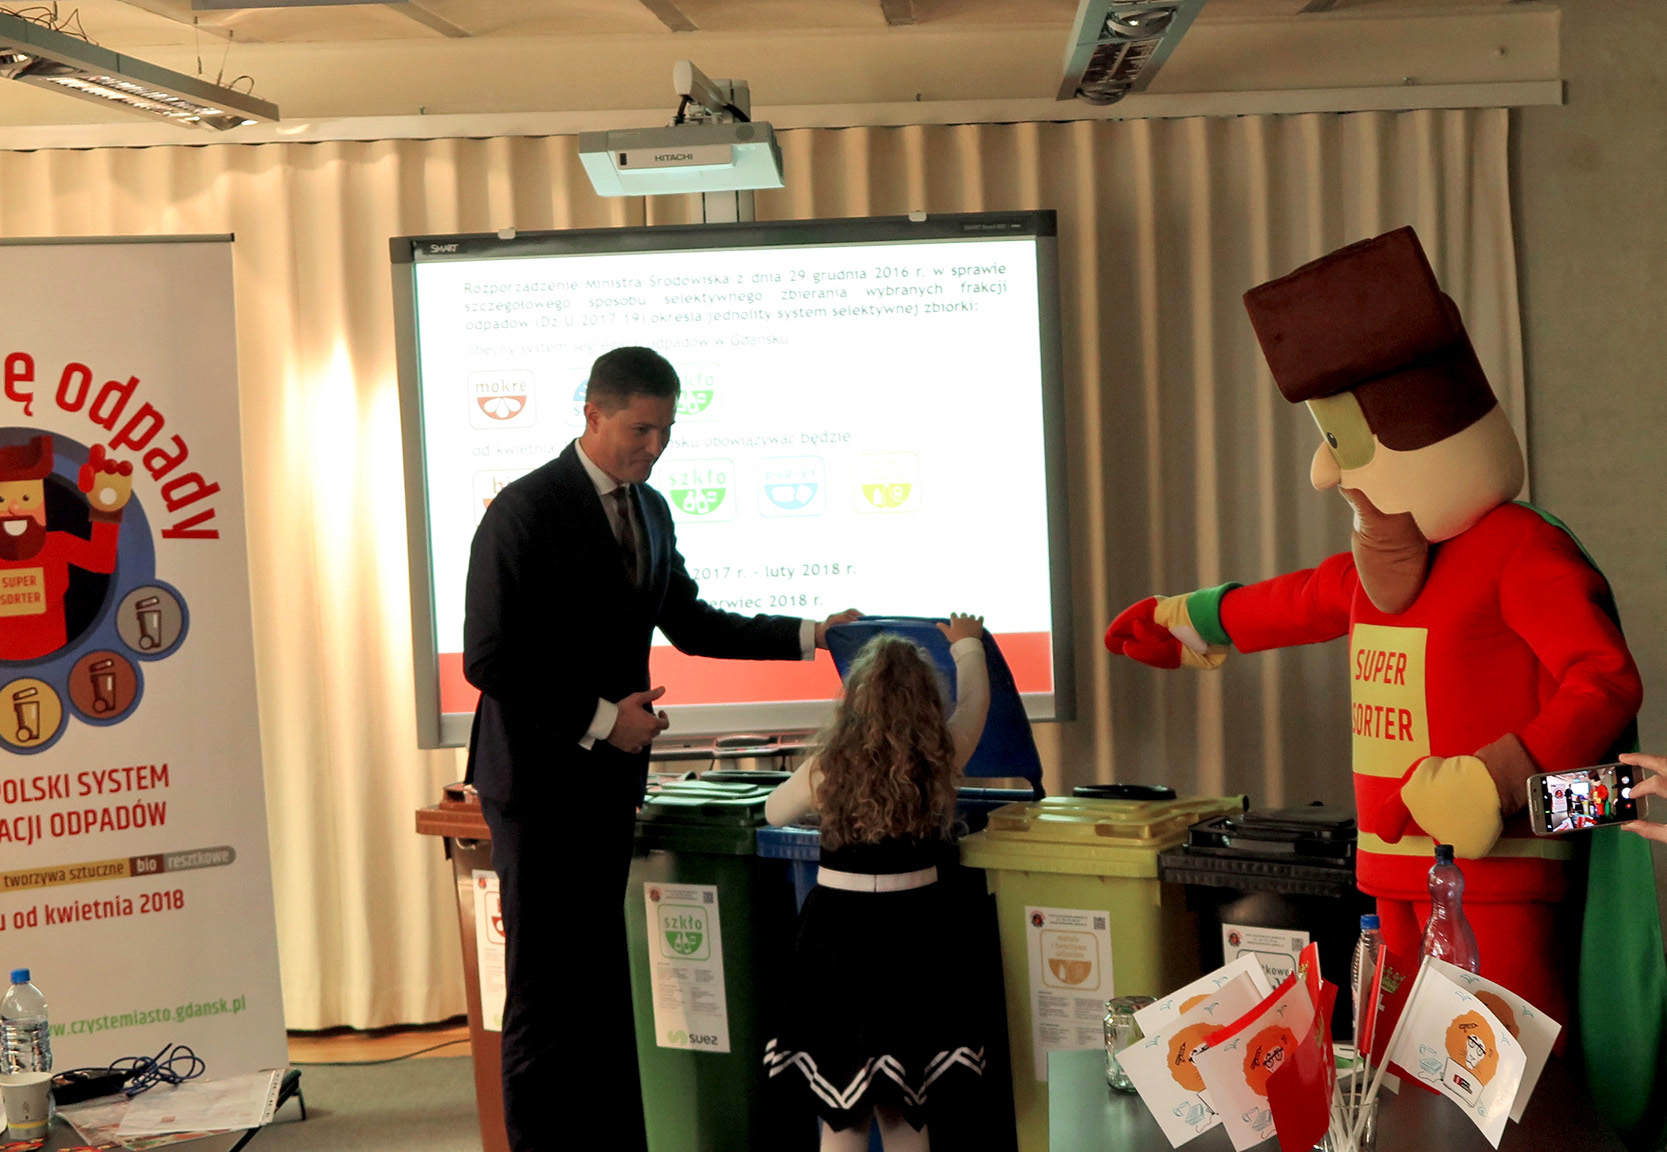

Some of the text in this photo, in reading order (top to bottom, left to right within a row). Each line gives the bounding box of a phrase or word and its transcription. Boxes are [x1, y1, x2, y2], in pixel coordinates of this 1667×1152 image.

[654, 153, 694, 162] HITACHI
[430, 243, 459, 254] SMART
[737, 274, 745, 284] z
[752, 272, 782, 283] dnia
[790, 270, 806, 282] 29
[813, 268, 867, 285] grudnia
[875, 266, 910, 280] 2016
[916, 268, 926, 278] r.
[932, 267, 944, 276] w
[951, 261, 1007, 279] sprawie
[589, 295, 647, 309] sposobu
[664, 291, 763, 307] selektywnego
[781, 287, 848, 301] zbierania
[866, 283, 943, 299] wybranych
[960, 280, 1007, 296] frakcji
[709, 307, 771, 325] jednolity
[778, 305, 826, 320] system
[832, 302, 918, 319] selektywnej
[714, 338, 725, 346] w
[475, 379, 528, 393] mokre
[800, 430, 852, 446] będzie
[55, 362, 221, 540] odpady
[472, 443, 490, 457] od
[496, 442, 555, 456] kwietnia
[669, 468, 726, 486] szkło
[692, 566, 731, 580] 2017
[737, 568, 747, 579] r.
[766, 563, 795, 581] luty
[802, 562, 841, 577] 2018
[846, 564, 857, 575] r.
[2, 575, 37, 588] SUPER
[769, 593, 808, 608] 2018
[813, 595, 824, 606] r.
[1355, 648, 1408, 686] SUPER
[0, 763, 170, 804] OLSKI SYSTEM
[50, 798, 167, 838] ODPADÓW
[4, 849, 230, 888] tworzywa sztuczne bio resztkowe
[13, 906, 38, 929] od
[45, 895, 134, 925] kwietnia
[140, 889, 185, 914] 2018
[663, 914, 703, 930] szkło
[688, 1033, 719, 1046] suez
